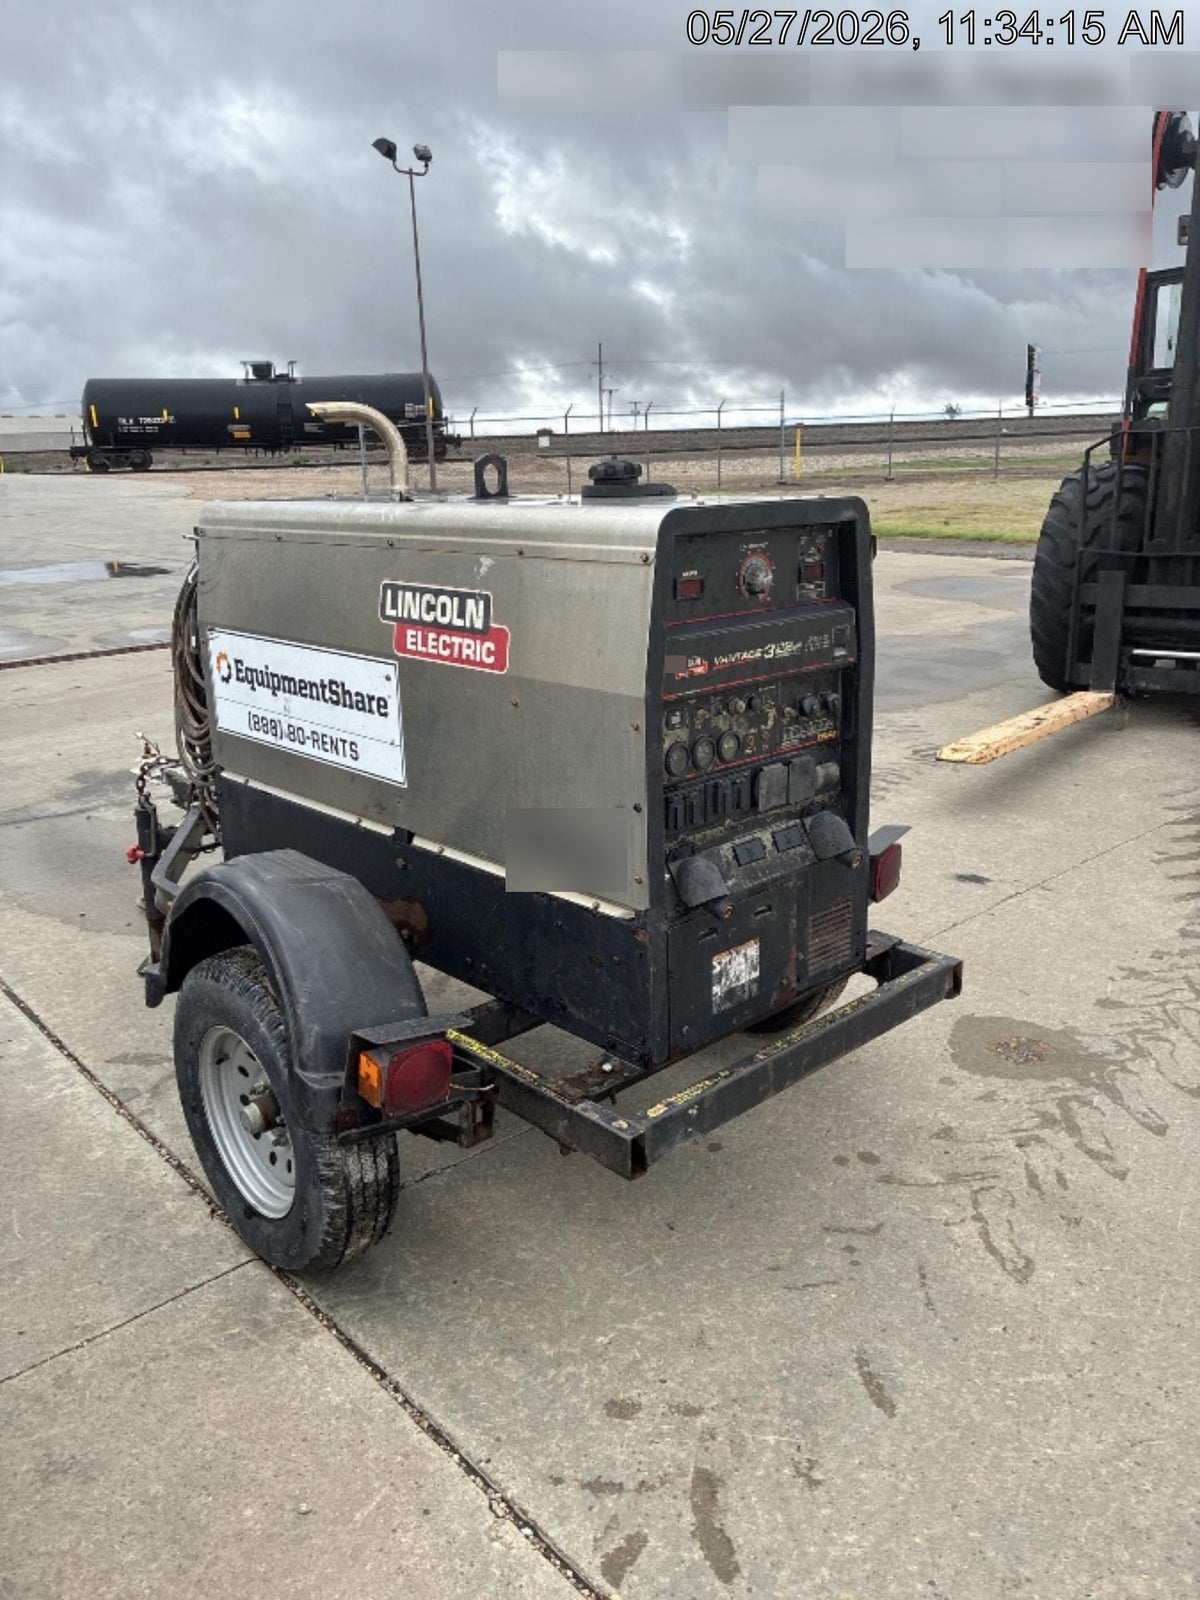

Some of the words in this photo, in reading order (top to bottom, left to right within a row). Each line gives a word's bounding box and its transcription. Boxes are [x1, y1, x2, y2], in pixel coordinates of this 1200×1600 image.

[385, 589, 485, 630] LINCOLN
[406, 629, 496, 664] ELECTRIC
[234, 658, 389, 718] EquipmentShare
[248, 711, 284, 740] (888)
[287, 724, 360, 762] 80-RENTS
